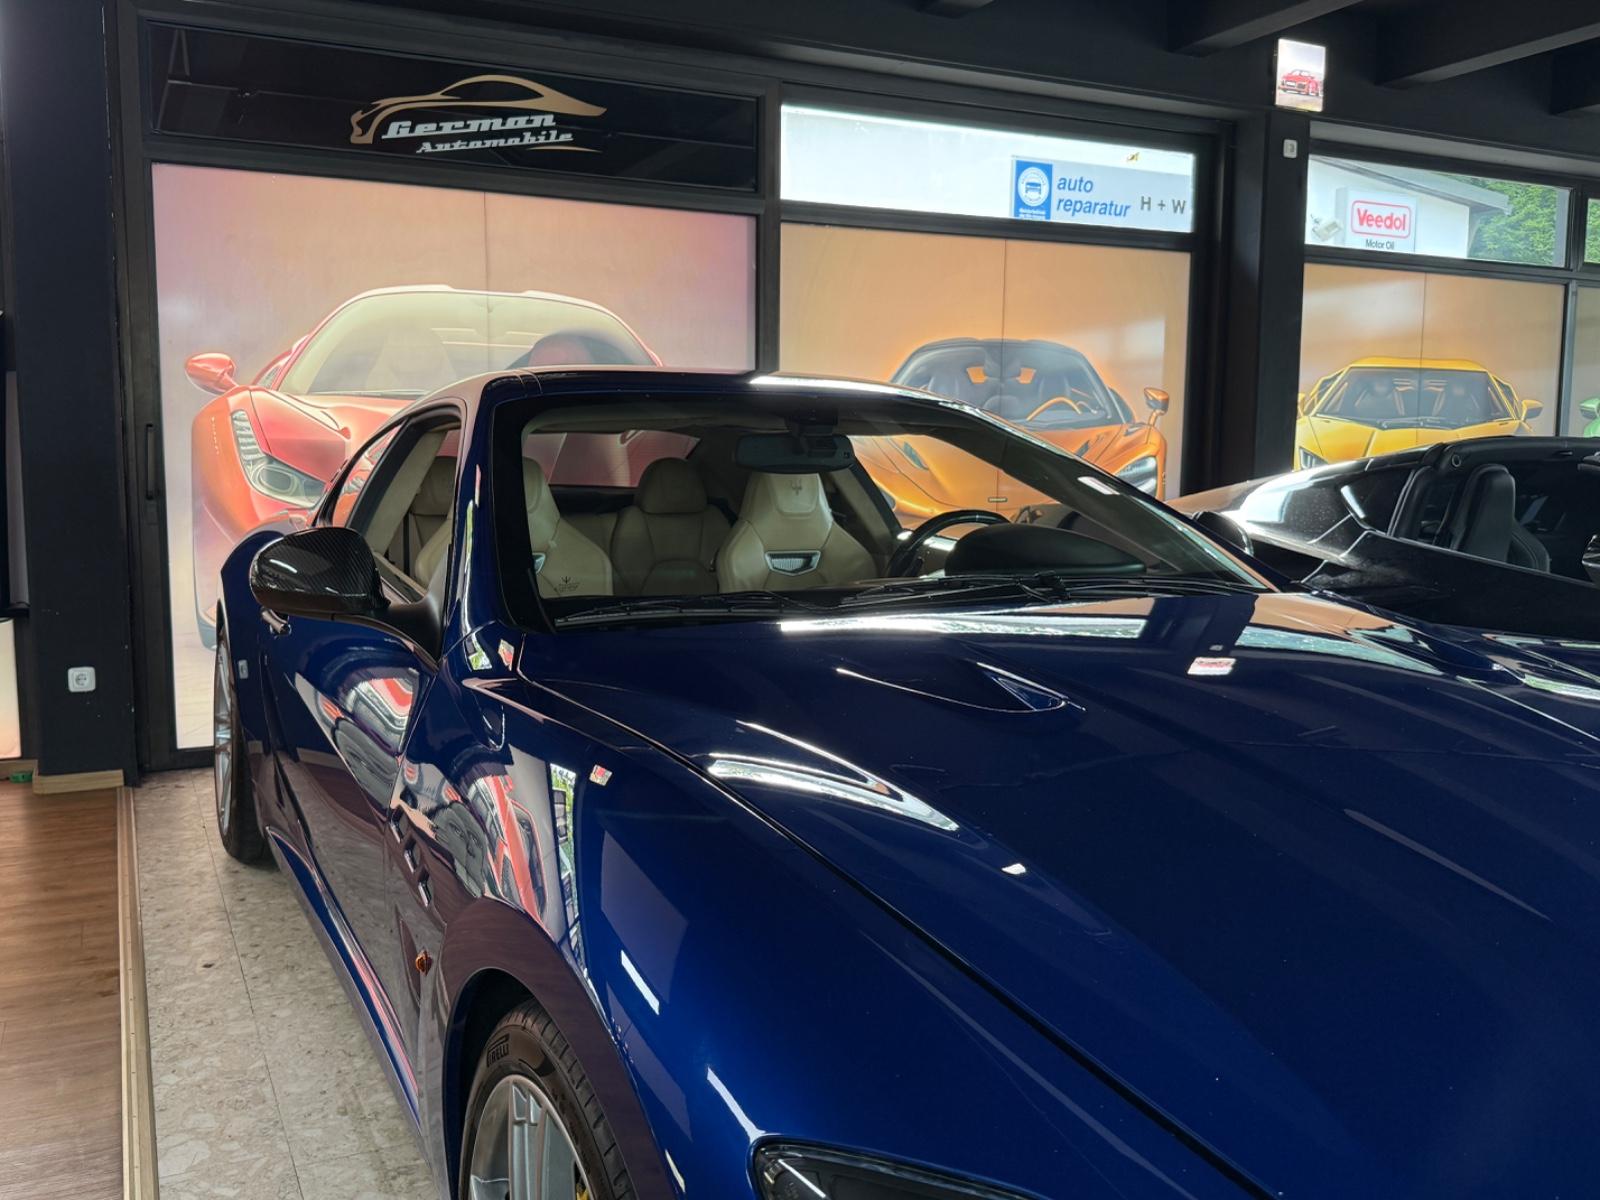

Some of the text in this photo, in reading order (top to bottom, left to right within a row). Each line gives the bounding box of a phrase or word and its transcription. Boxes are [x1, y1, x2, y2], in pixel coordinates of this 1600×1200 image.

[381, 114, 556, 139] German
[416, 130, 573, 153] Automobile
[1057, 176, 1094, 193] auto
[1056, 197, 1131, 217] reparatur
[1140, 196, 1152, 212] H
[1172, 199, 1187, 214] W
[1356, 207, 1406, 231] Veedol
[1365, 238, 1394, 250] Motor Oil
[486, 1033, 510, 1068] PIRELLI
